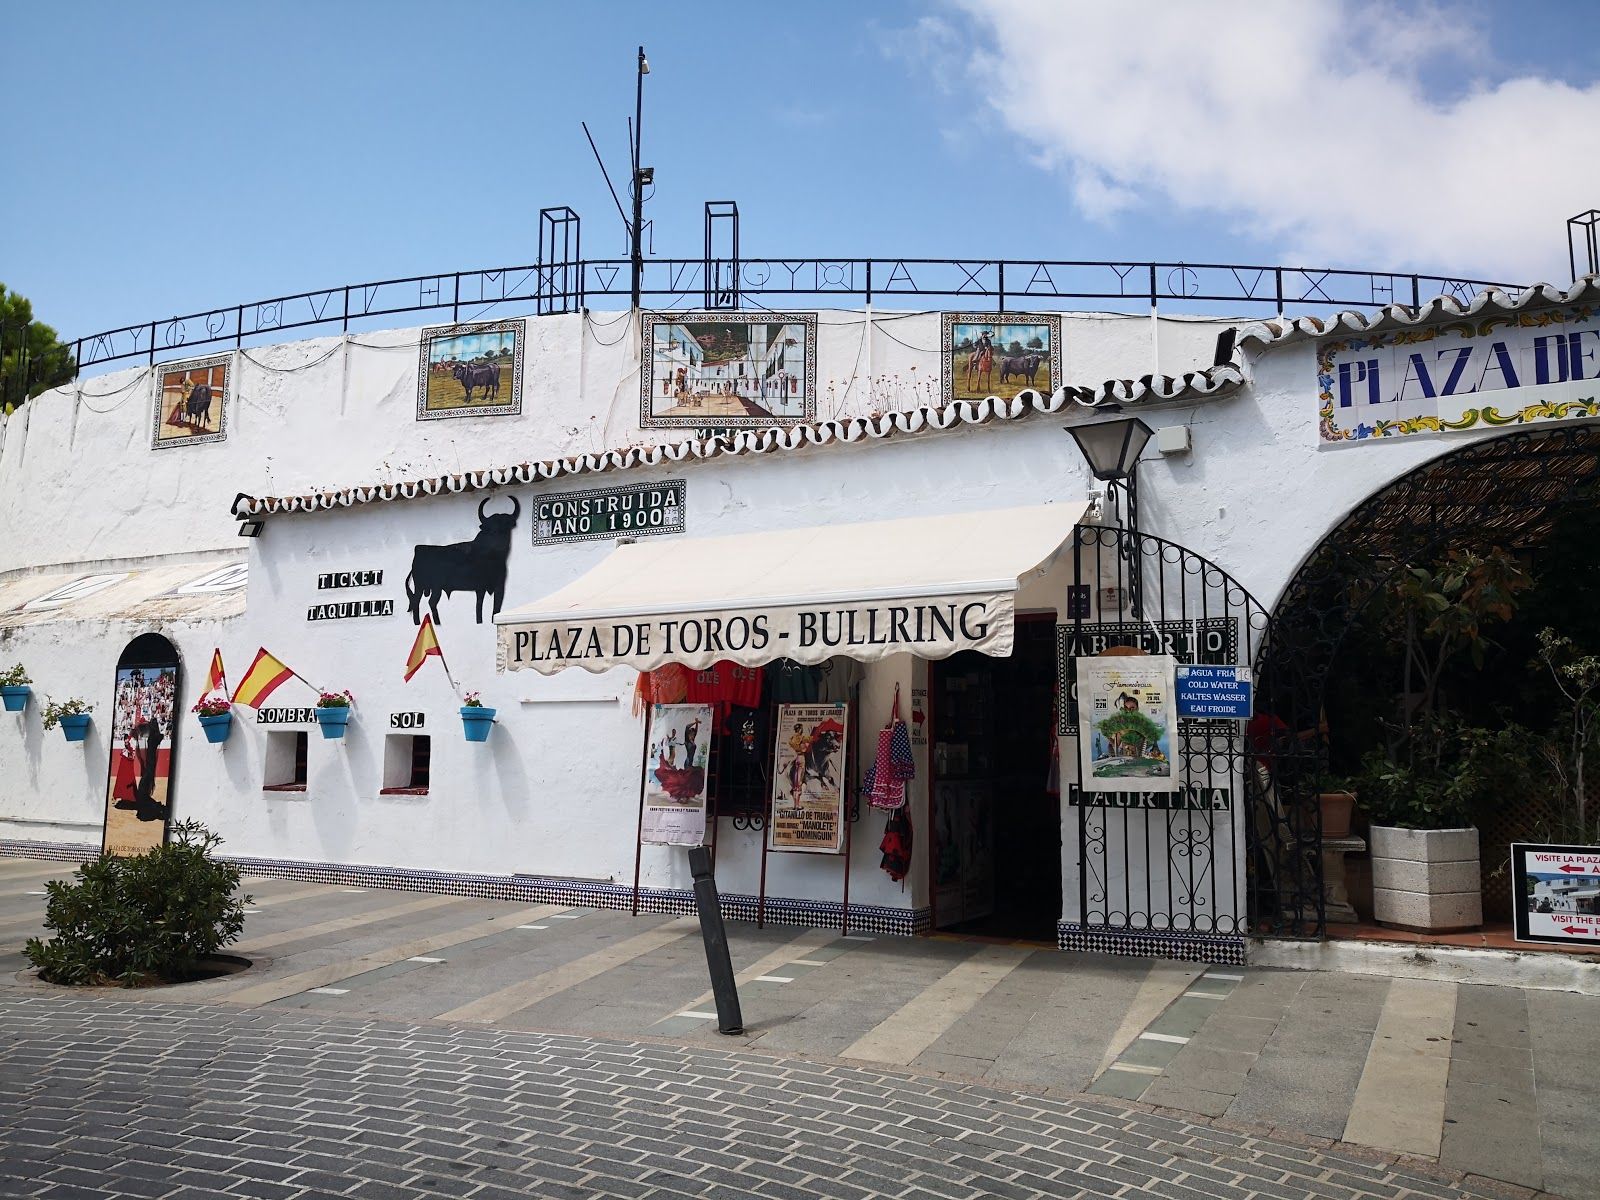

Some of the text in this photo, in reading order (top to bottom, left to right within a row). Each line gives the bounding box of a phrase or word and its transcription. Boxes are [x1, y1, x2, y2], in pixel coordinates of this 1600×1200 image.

[1338, 329, 1600, 408] PLAZA DE
[539, 489, 677, 520] CONSTRUIDA
[609, 508, 663, 530] 1900
[319, 570, 382, 589] TICKET
[308, 600, 393, 620] TAQUILLA
[514, 626, 604, 662] PLAZA
[613, 624, 651, 658] DE
[660, 615, 769, 654] TOROS
[798, 603, 989, 648] BULLRING
[1190, 669, 1235, 677] AGUA FRIA
[1188, 681, 1239, 689] COLD WATER
[1181, 693, 1246, 702] KALTES WASSER
[258, 707, 317, 724] SOMBRA
[1190, 705, 1237, 713] EAU FROIDE
[391, 712, 424, 729] SOL
[805, 811, 813, 820] DE
[800, 821, 836, 831] "MANOLETE"
[1535, 854, 1600, 864] VISITE LA PLAZ
[1551, 915, 1573, 923] VISIT
[1576, 916, 1592, 924] THE
